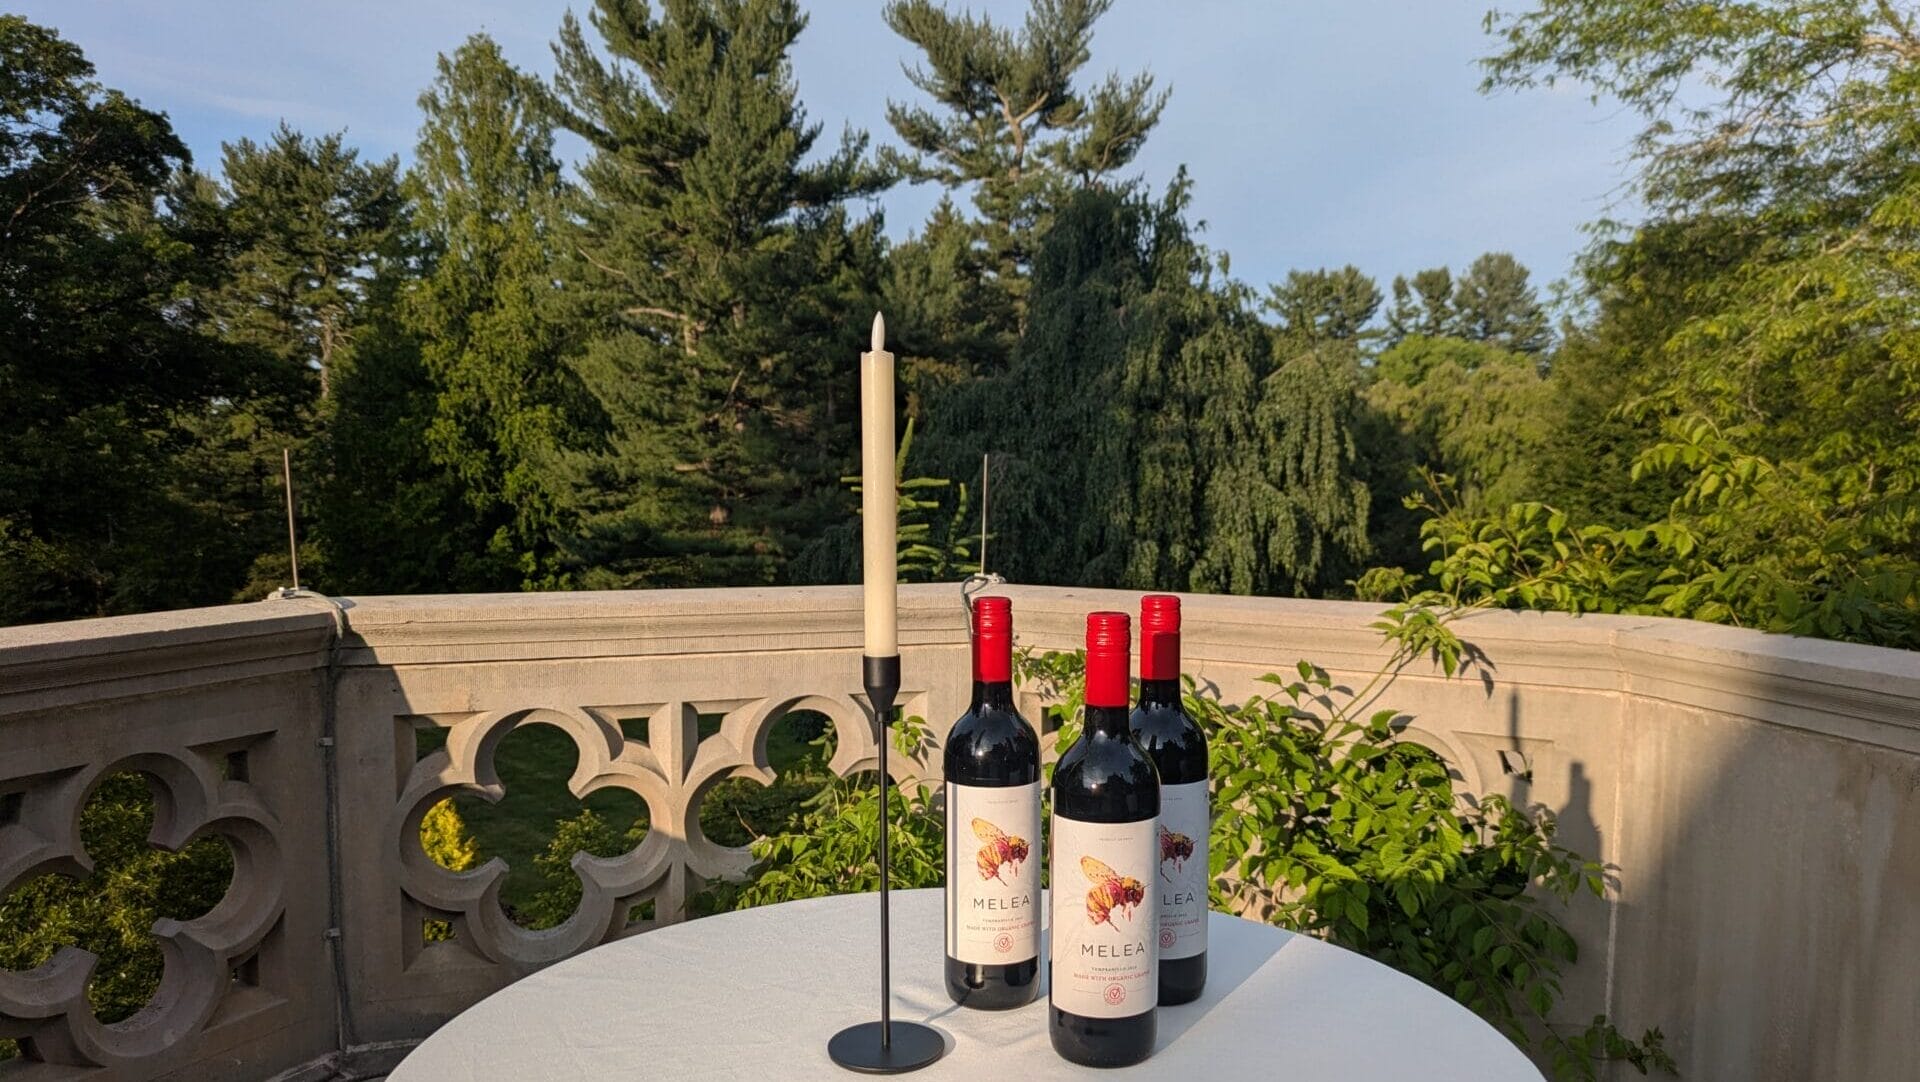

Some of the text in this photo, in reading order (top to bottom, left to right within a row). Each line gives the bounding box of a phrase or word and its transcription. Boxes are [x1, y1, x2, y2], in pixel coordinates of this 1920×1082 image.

[973, 894, 1030, 910] MELEA
[1162, 892, 1194, 906] LEA
[1081, 942, 1145, 958] MELEA
